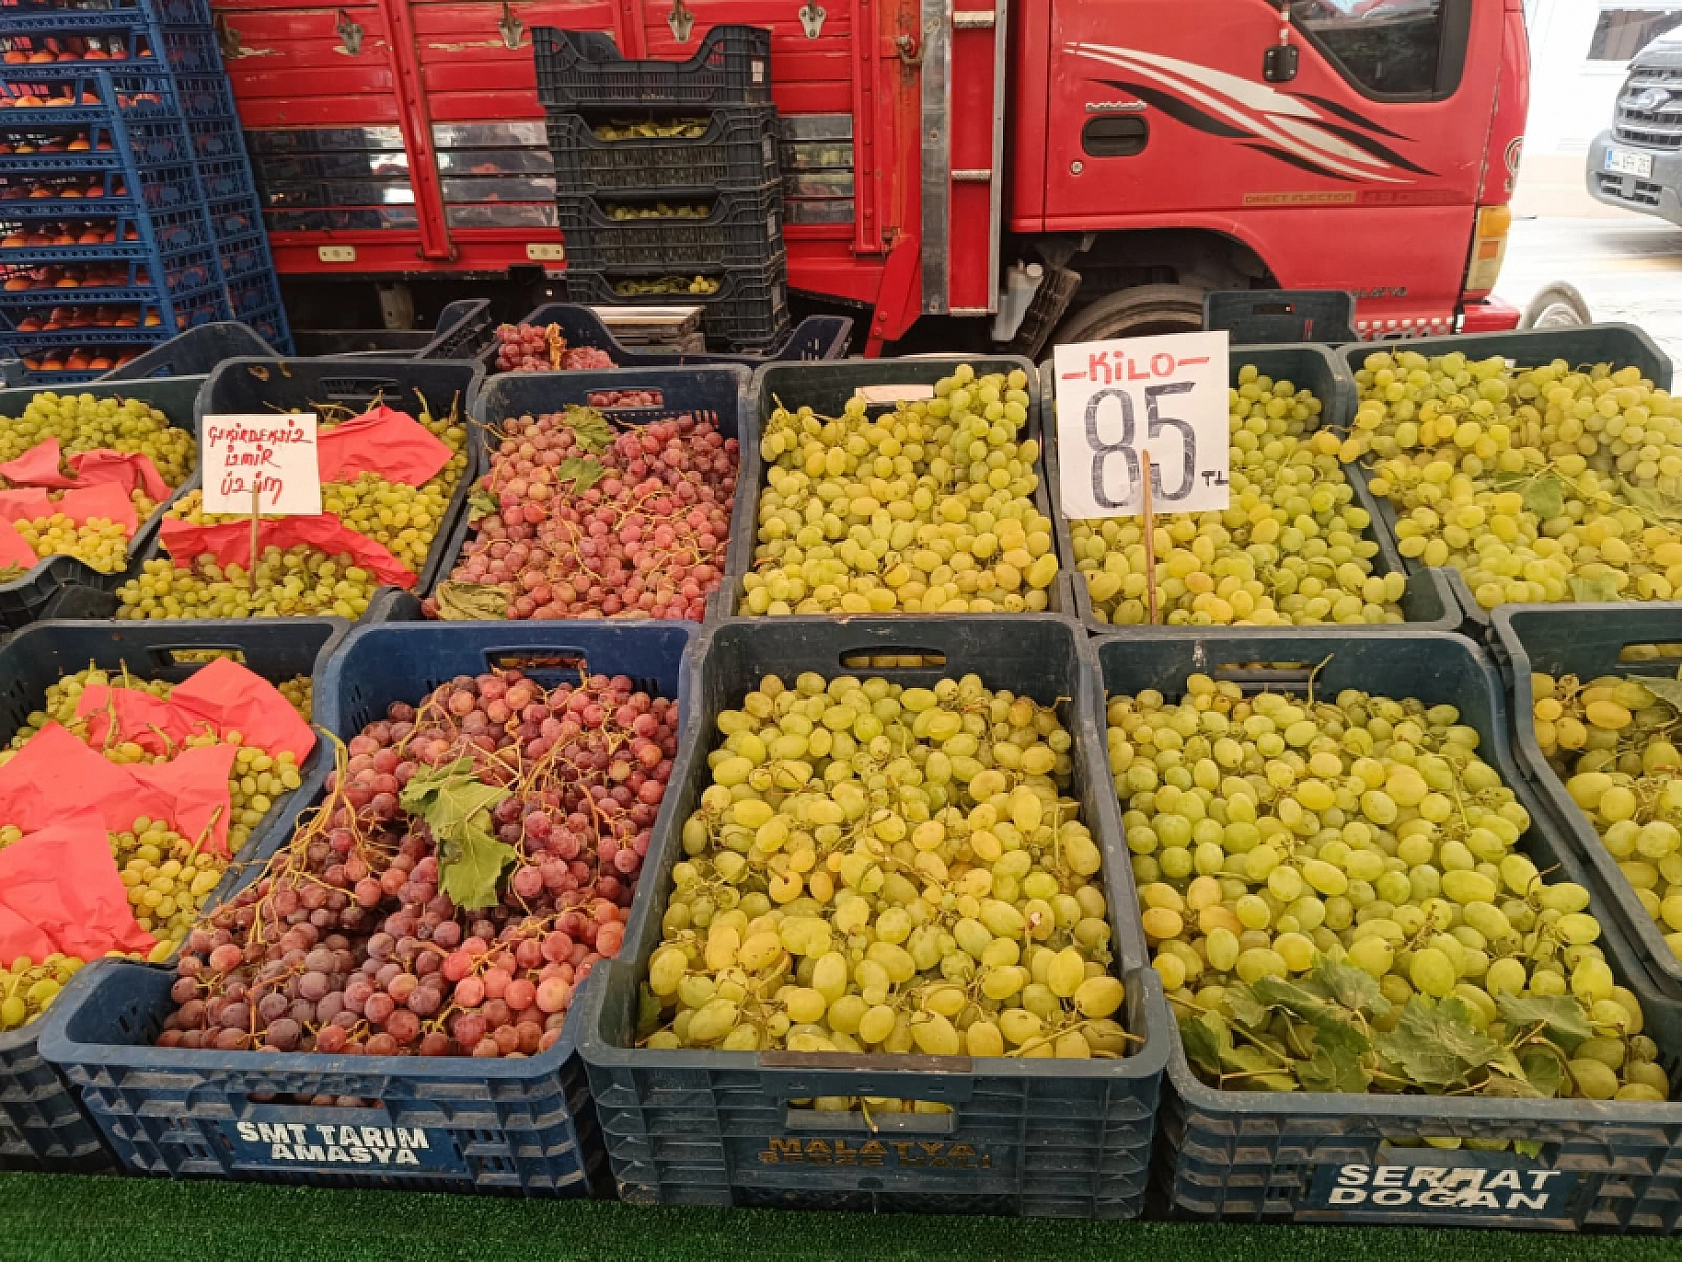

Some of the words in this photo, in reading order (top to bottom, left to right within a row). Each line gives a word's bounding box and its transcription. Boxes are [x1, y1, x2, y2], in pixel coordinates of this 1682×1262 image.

[1084, 381, 1197, 508] 85
[1202, 470, 1229, 487] TL
[237, 1122, 306, 1144] SMT
[317, 1125, 429, 1148] TARIM
[768, 1136, 977, 1156] MALATYA
[271, 1143, 420, 1165] AMASYA
